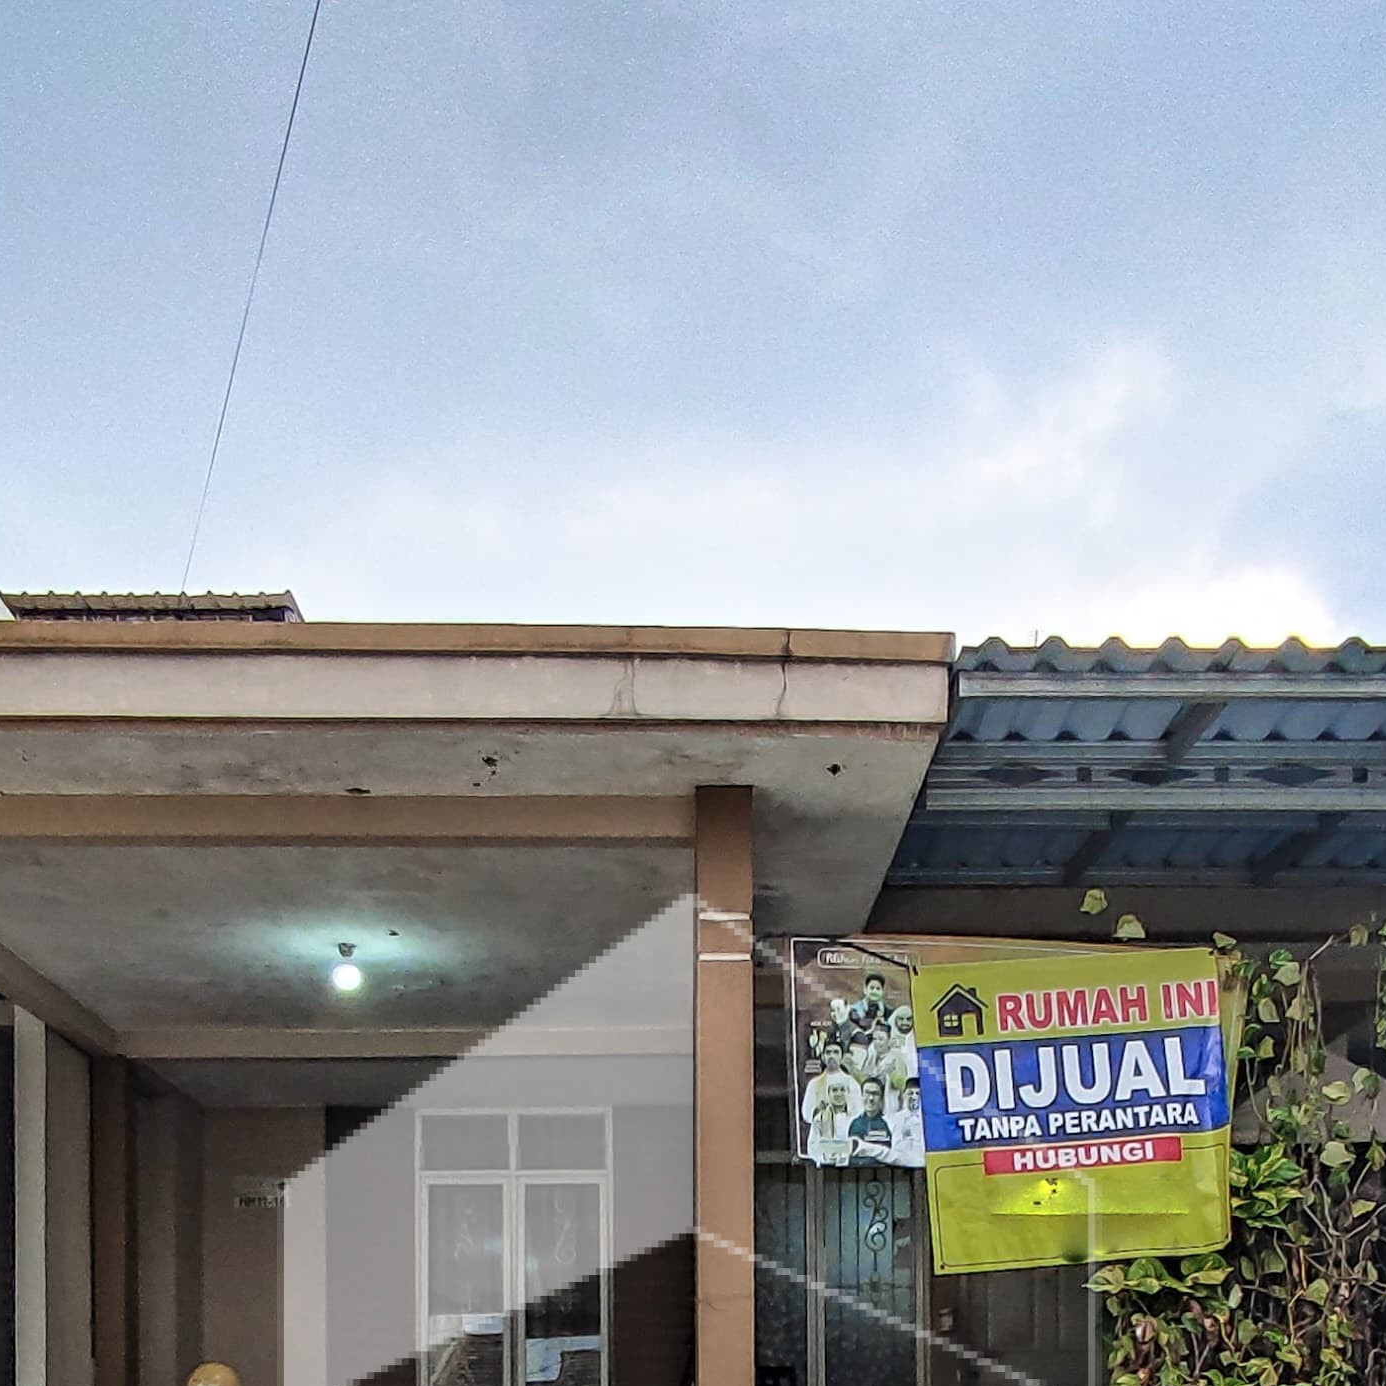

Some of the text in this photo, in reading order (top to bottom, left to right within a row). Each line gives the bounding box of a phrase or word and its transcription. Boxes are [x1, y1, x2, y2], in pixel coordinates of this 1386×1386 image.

[997, 979, 1218, 1032] RUMAH INI
[943, 1036, 1206, 1114] DIJUAL
[959, 1103, 1199, 1142] TANPA PERANTARA
[1013, 1141, 1155, 1171] HUBUNGI
